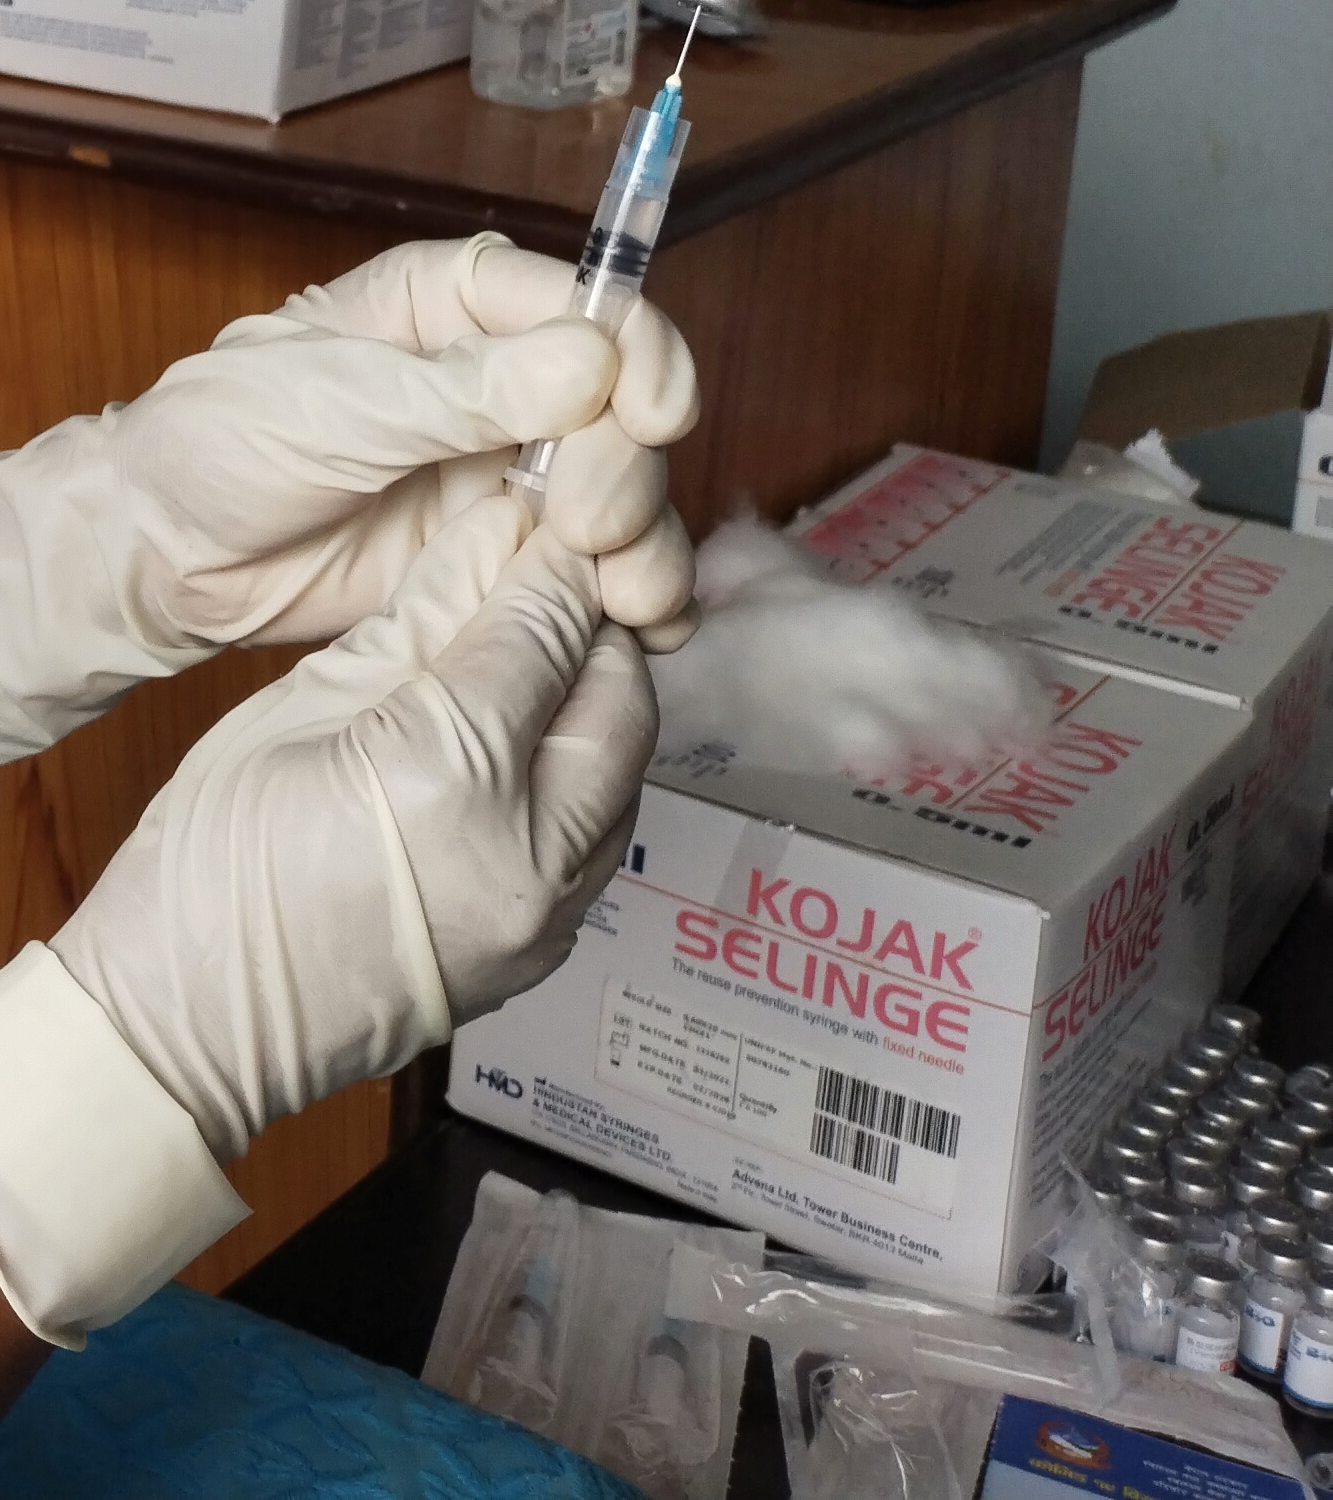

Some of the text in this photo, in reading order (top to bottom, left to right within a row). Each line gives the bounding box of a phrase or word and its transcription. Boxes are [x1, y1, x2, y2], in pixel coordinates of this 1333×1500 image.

[1154, 554, 1287, 641] KOJAK
[964, 722, 1142, 833] KOJAK
[746, 868, 978, 991] KOJAK
[1084, 823, 1177, 960] KOJAK
[672, 956, 965, 1075] The reuse prevention syringe with fixed needle
[675, 909, 971, 1053] SELINGE
[1041, 889, 1168, 1062] SELINGE
[596, 1125, 645, 1151] DEVICES
[803, 1196, 839, 1218] Tower
[841, 1211, 896, 1242] Business
[899, 1234, 943, 1262] Centre,
